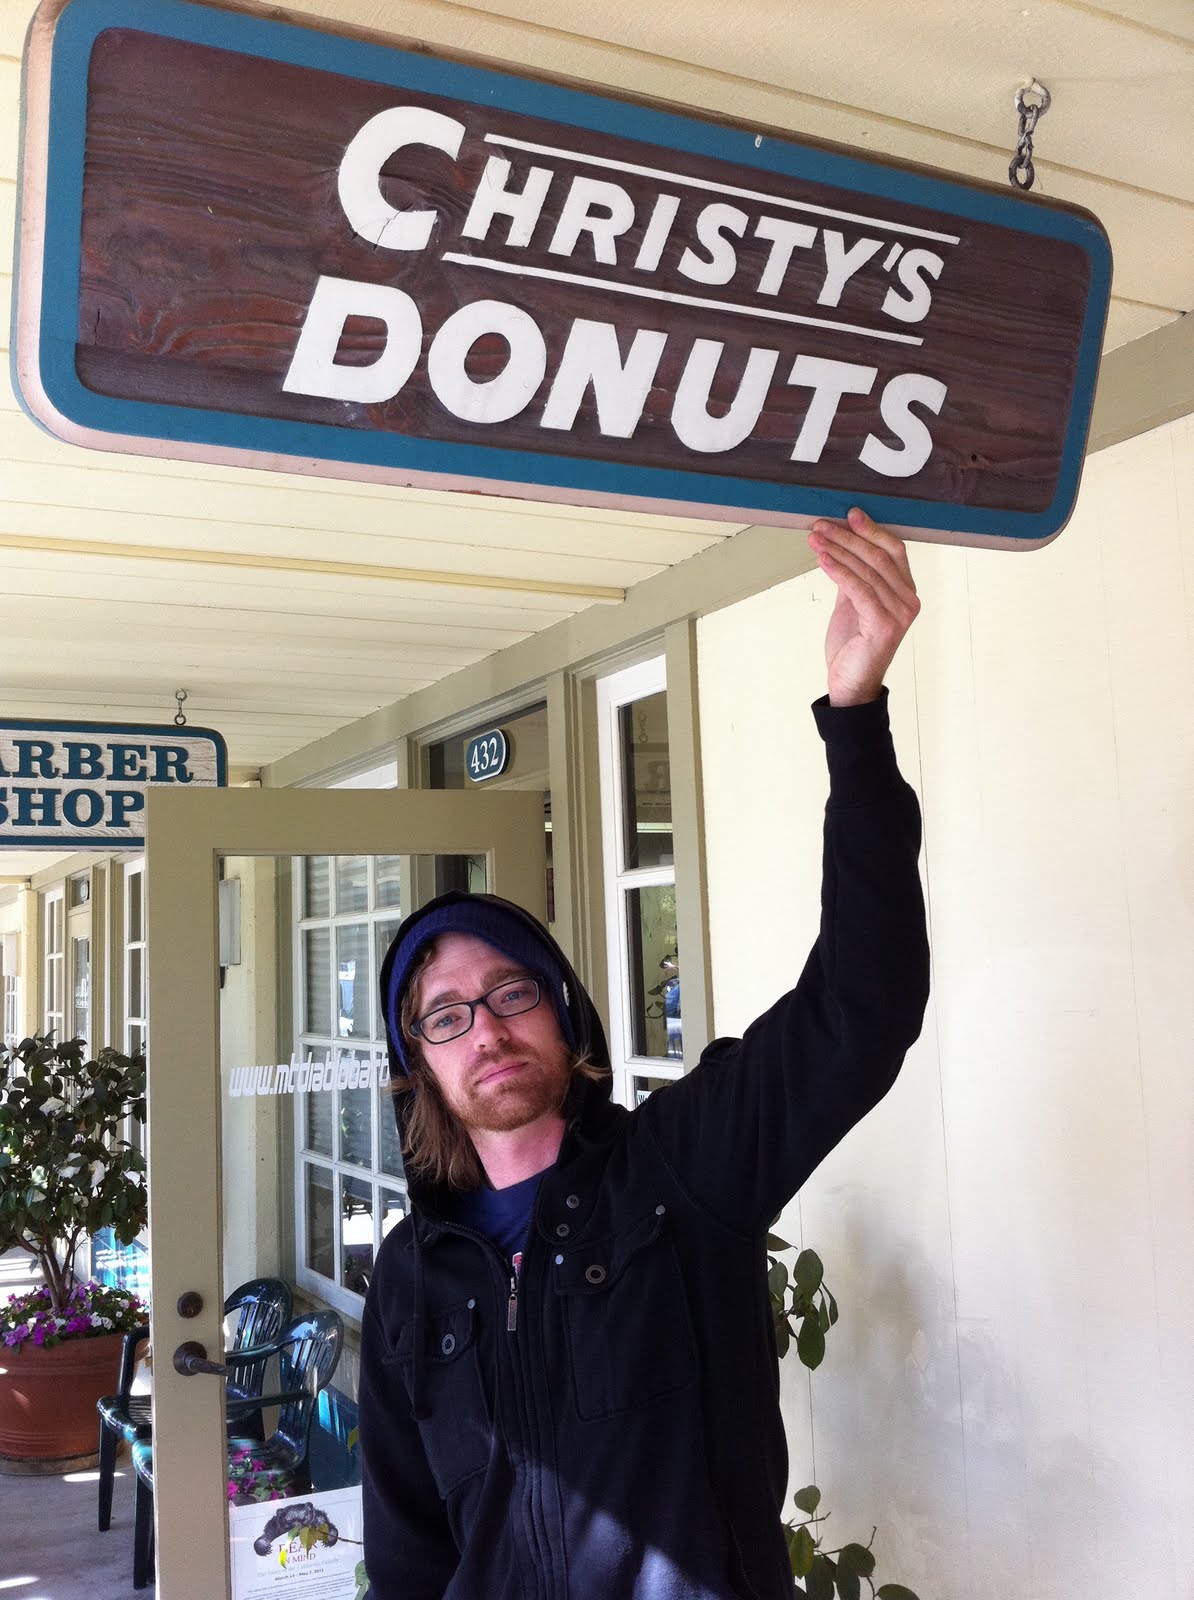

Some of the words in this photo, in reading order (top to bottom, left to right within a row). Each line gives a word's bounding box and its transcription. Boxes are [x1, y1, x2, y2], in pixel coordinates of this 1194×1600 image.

[337, 105, 945, 323] CHRISTY'S
[281, 275, 948, 478] DONUTS
[0, 740, 194, 783] RBER
[471, 737, 499, 773] 432
[0, 786, 145, 828] HOP
